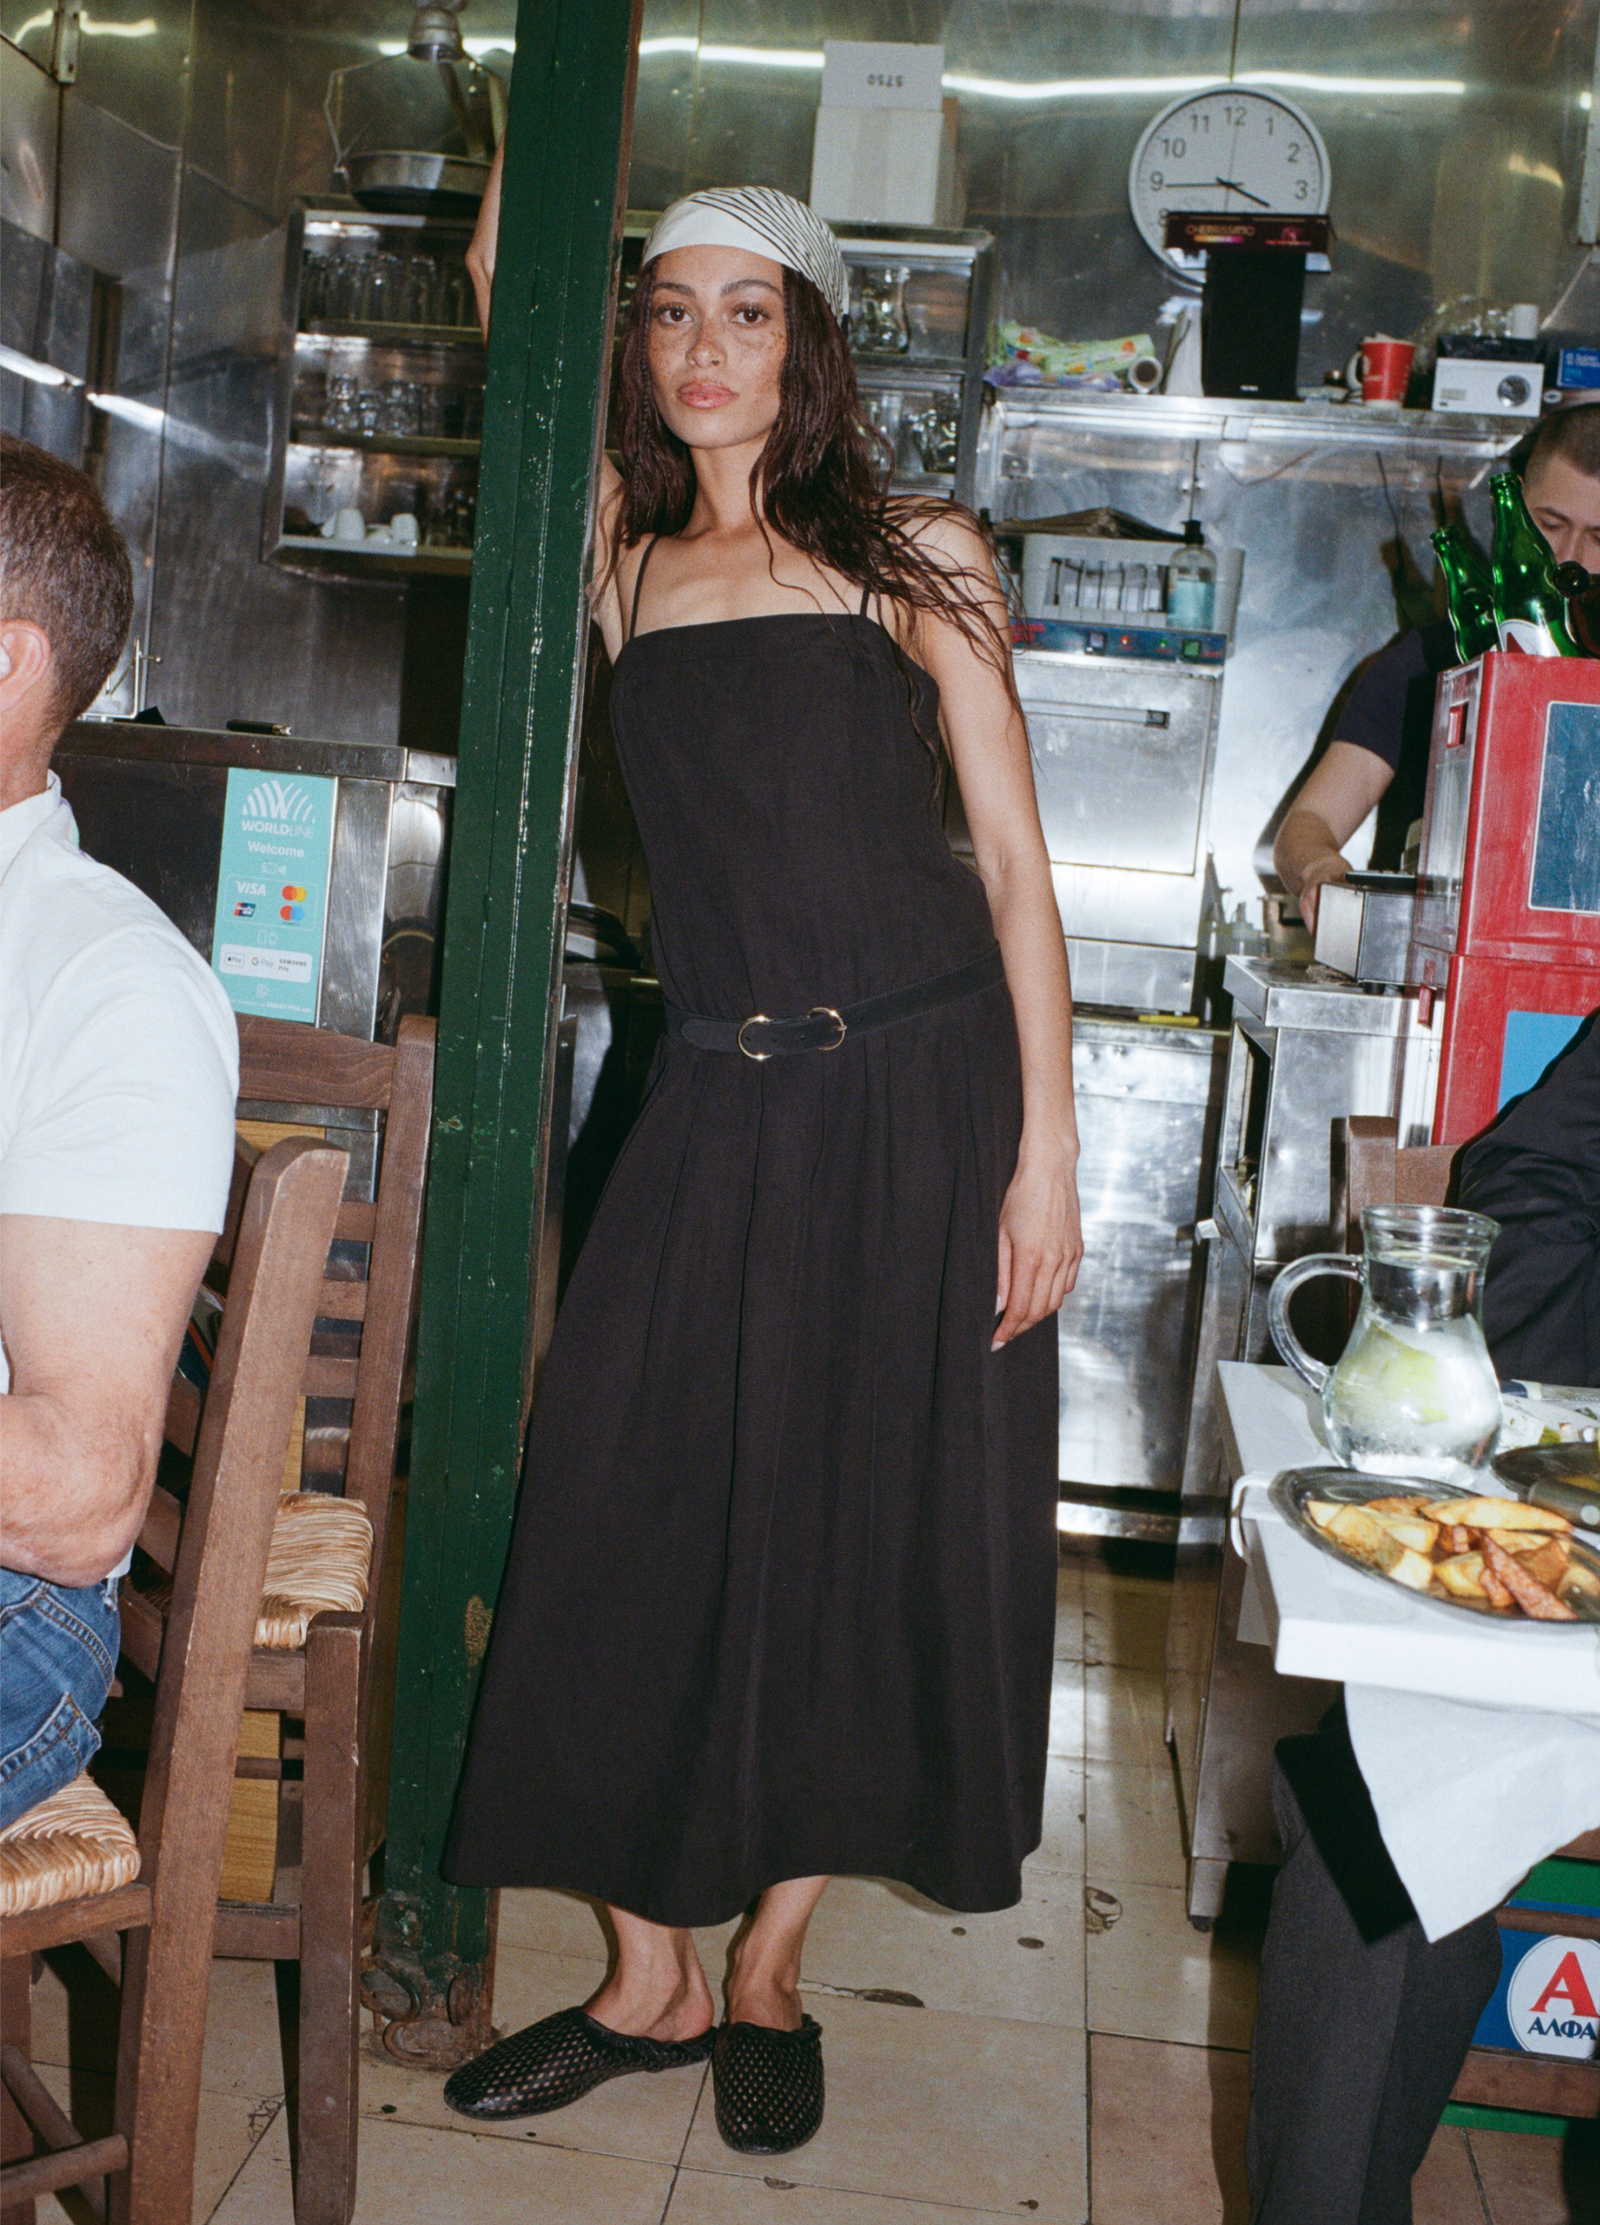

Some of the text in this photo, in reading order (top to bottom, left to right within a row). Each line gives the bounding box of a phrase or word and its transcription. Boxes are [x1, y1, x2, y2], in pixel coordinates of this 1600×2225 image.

[1190, 114, 1210, 133] 11
[1225, 106, 1247, 126] 12
[1265, 117, 1274, 136] 1
[1162, 137, 1187, 158] 10
[1287, 142, 1300, 163] 2
[1150, 171, 1164, 191] 9
[1295, 179, 1308, 200] 3
[241, 819, 314, 839] WORLDLINE
[248, 840, 305, 857] Welcome
[236, 881, 267, 896] VISA
[279, 958, 307, 967] SAMSUNG
[1527, 2016, 1598, 2040] ΑΛΦΑ
